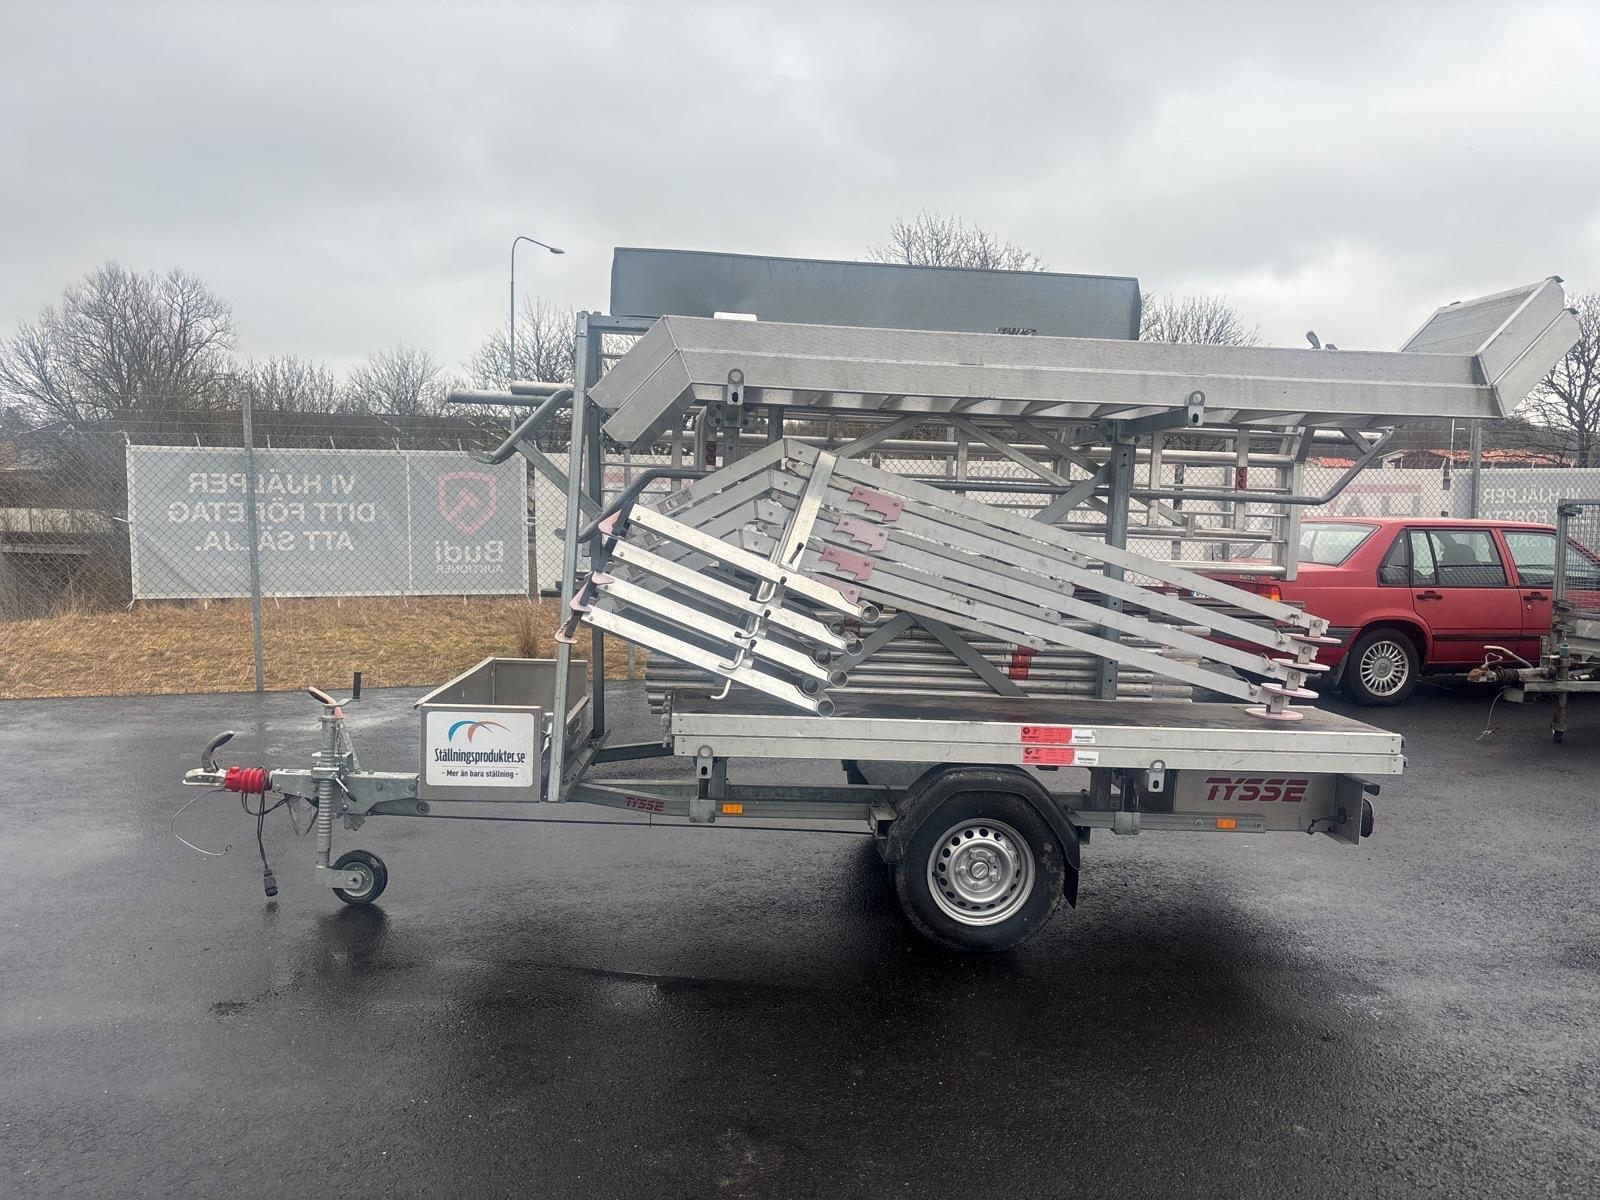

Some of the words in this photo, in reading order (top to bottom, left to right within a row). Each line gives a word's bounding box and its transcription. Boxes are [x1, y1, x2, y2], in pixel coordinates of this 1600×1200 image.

[434, 747, 526, 765] Ställningsprodukter.se
[446, 769, 459, 777] Mer
[460, 769, 468, 777] än
[469, 770, 484, 778] bara
[485, 770, 514, 779] ställning
[1205, 777, 1310, 802] TYSSE
[624, 796, 665, 811] TYSSE
